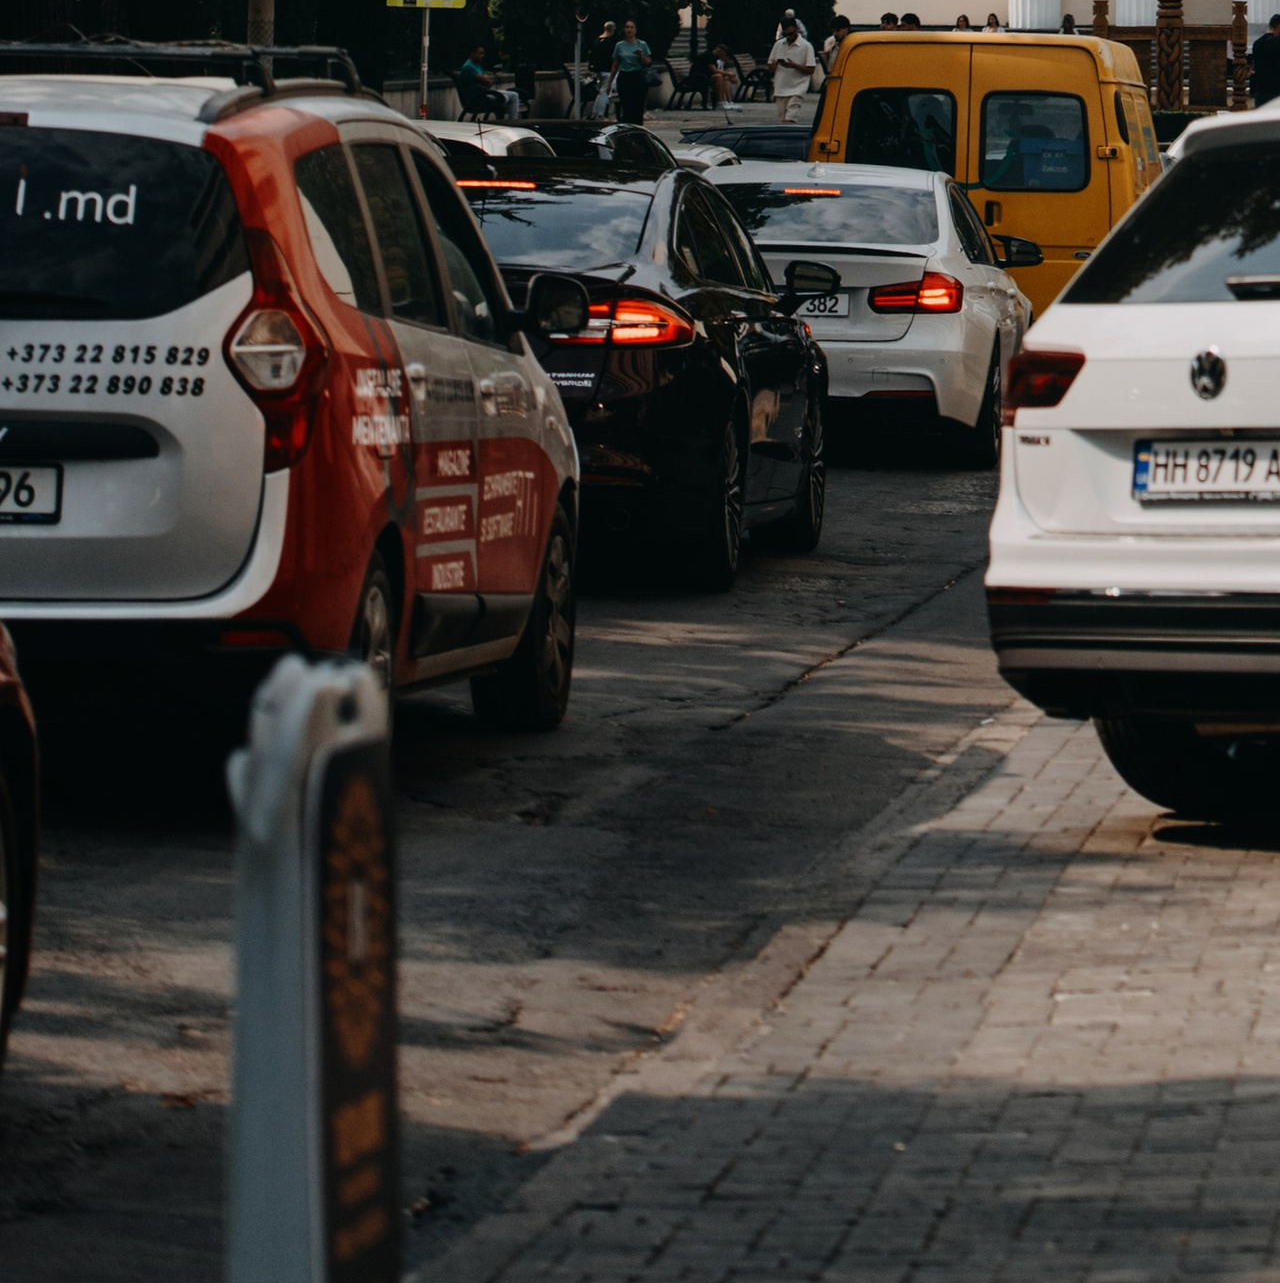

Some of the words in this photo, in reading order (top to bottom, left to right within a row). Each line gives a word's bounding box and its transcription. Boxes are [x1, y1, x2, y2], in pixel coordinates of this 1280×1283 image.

[7, 344, 66, 363] +373
[74, 345, 103, 363] 22
[112, 345, 157, 364] 815
[165, 346, 210, 366] 829
[2, 374, 61, 393] +373
[69, 375, 99, 394] 22
[106, 375, 152, 395] 890
[159, 377, 205, 397] 838
[1153, 449, 1189, 483] HH
[1197, 448, 1257, 483] 8719
